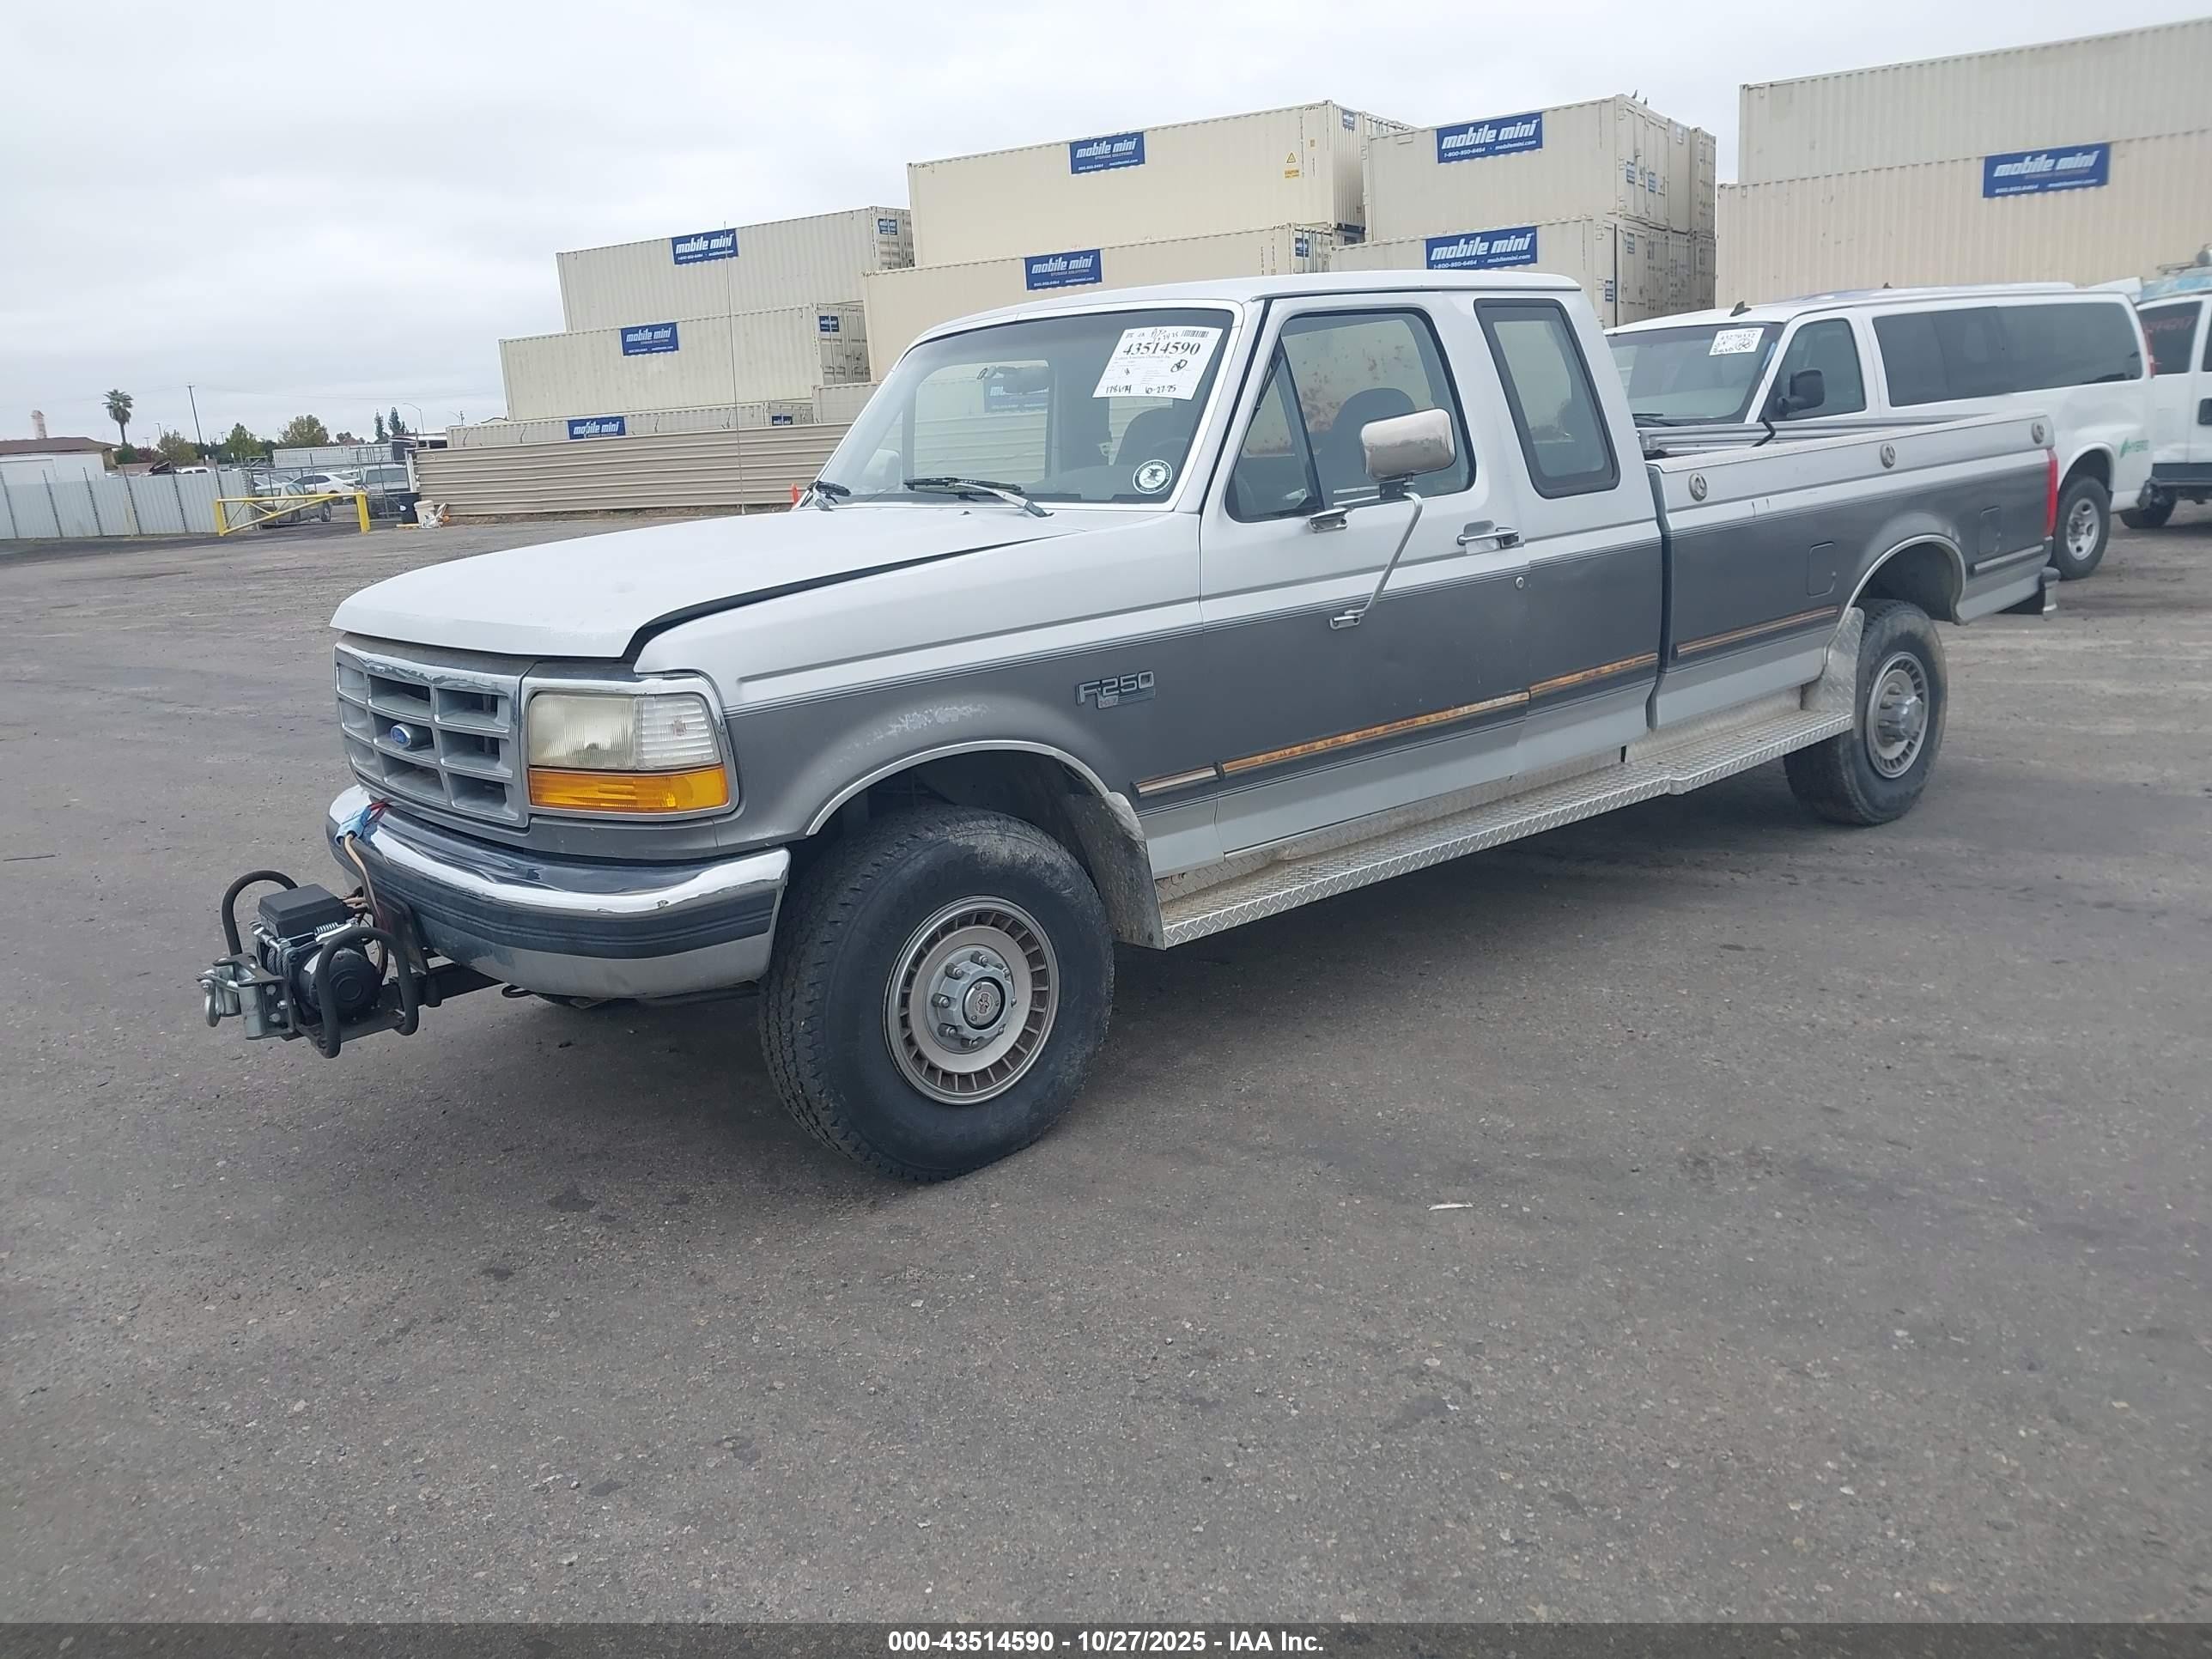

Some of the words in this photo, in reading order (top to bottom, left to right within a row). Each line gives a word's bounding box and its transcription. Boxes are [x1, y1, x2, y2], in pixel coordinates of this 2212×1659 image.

[1442, 124, 1498, 149] mobile
[1498, 119, 1537, 141] mini
[1076, 141, 1112, 159] mobile
[1112, 137, 1137, 154] mini
[1993, 154, 2056, 178] mobile
[2056, 150, 2100, 171] mini
[676, 236, 709, 255] mobile
[709, 233, 733, 250] mini
[1431, 236, 1490, 261] mobile
[1490, 233, 1532, 254] mini
[1031, 257, 1067, 275] mobile
[1067, 254, 1093, 270] mini
[626, 328, 653, 343] mobile
[653, 326, 672, 340] mini
[1123, 342, 1200, 356] 43514590
[600, 421, 620, 434] mini
